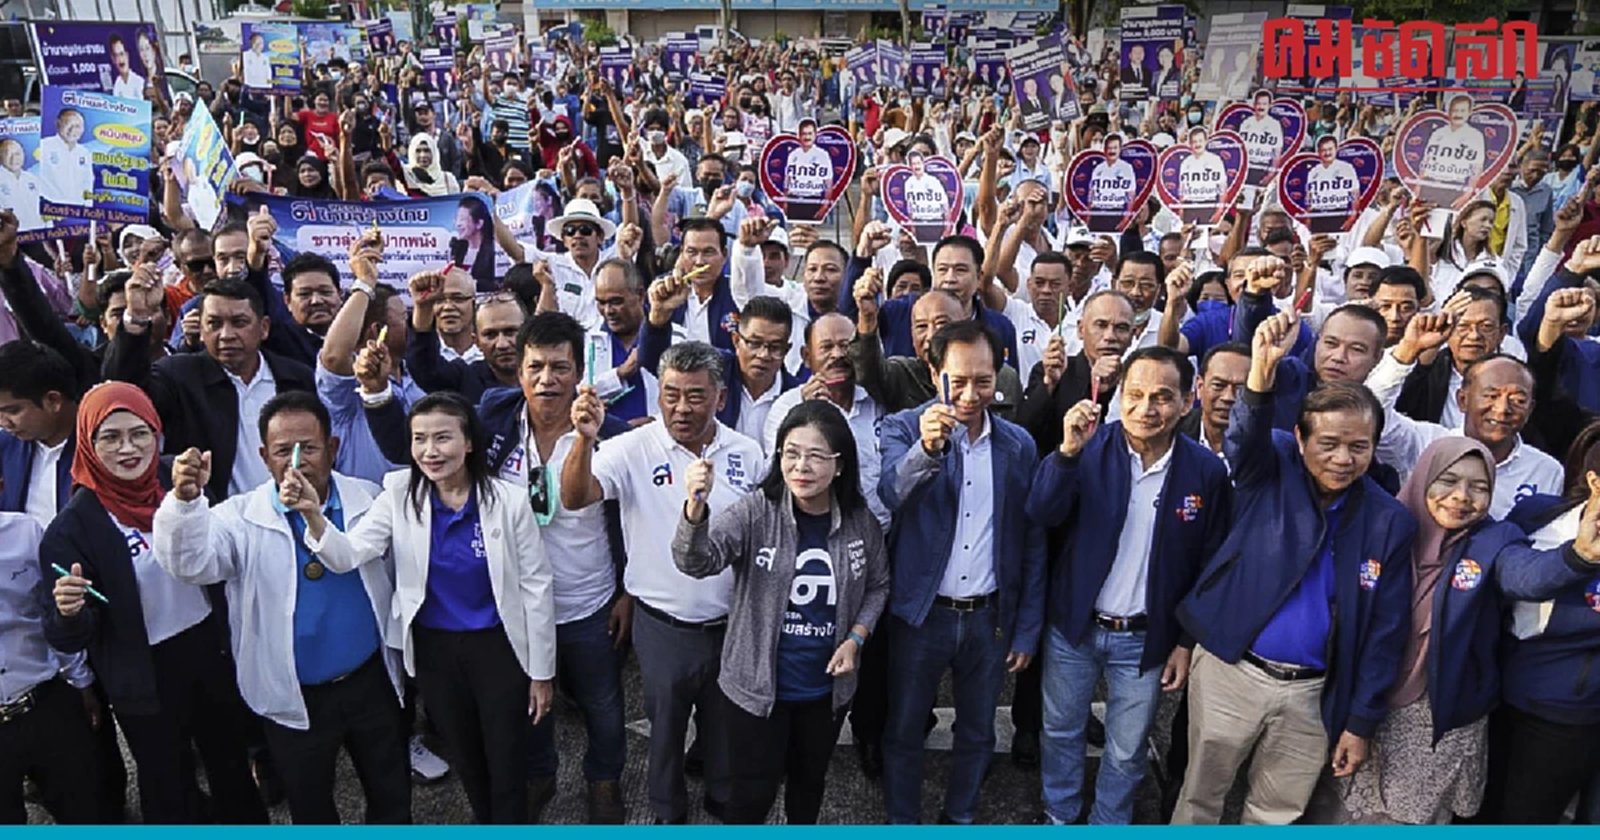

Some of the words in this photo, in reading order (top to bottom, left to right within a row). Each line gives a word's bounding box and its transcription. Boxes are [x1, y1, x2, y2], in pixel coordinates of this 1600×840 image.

[100, 128, 142, 144] สนับสนุน
[1427, 143, 1477, 161] ศุภชัย
[786, 164, 828, 182] ศุภชัย
[1180, 168, 1221, 187] ศุภชัย
[1091, 176, 1131, 194] ศุภชัย
[1307, 177, 1352, 195] ศุภชัย
[907, 188, 942, 205] ศุภชัย
[785, 611, 802, 620] รรค
